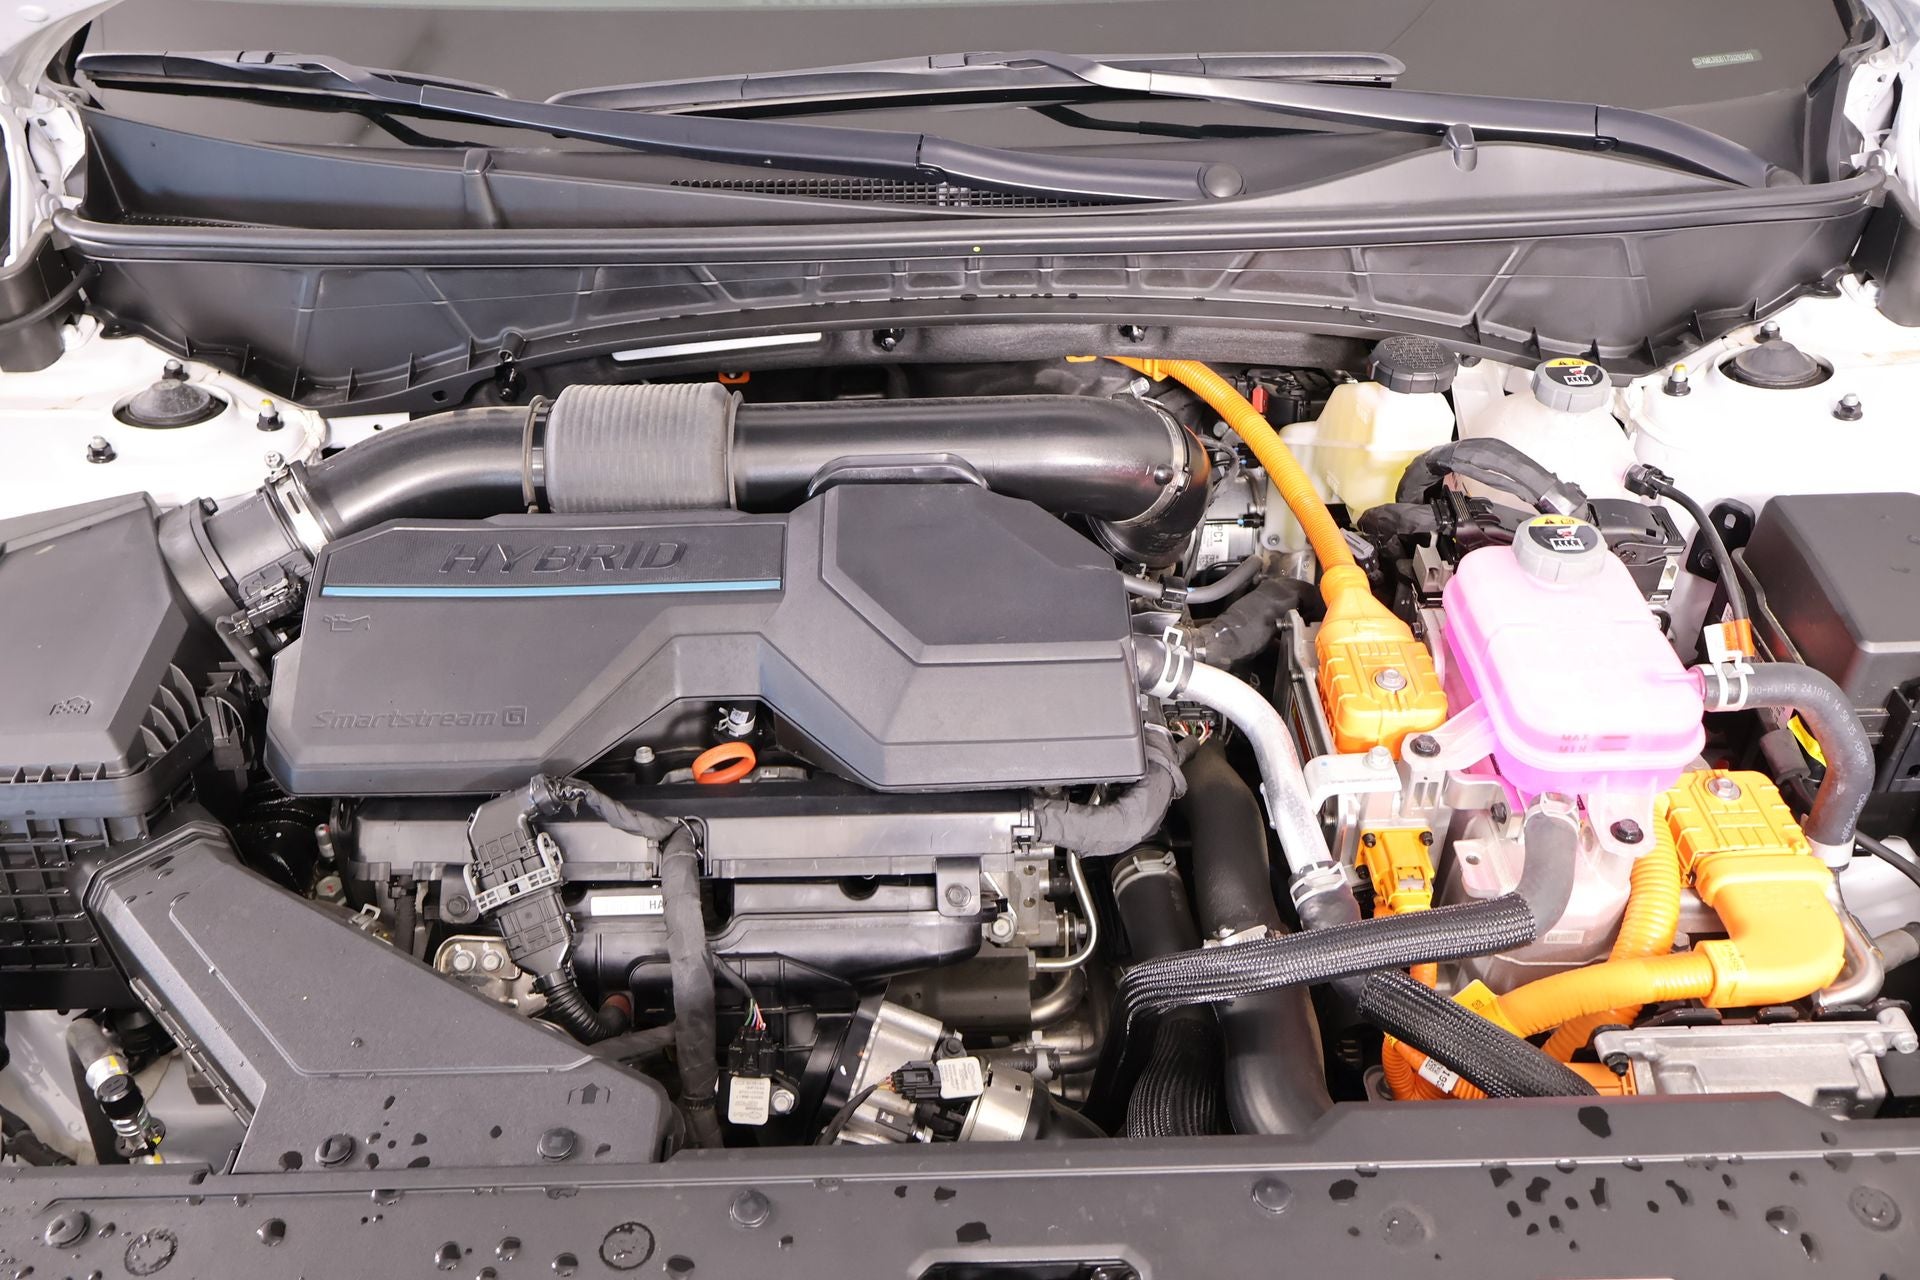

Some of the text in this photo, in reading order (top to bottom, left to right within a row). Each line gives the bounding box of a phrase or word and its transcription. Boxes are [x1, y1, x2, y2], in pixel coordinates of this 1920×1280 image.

[439, 542, 687, 573] HYBRID
[311, 708, 499, 730] Smartstream
[1561, 734, 1589, 742] MAX
[1558, 745, 1587, 753] MIN
